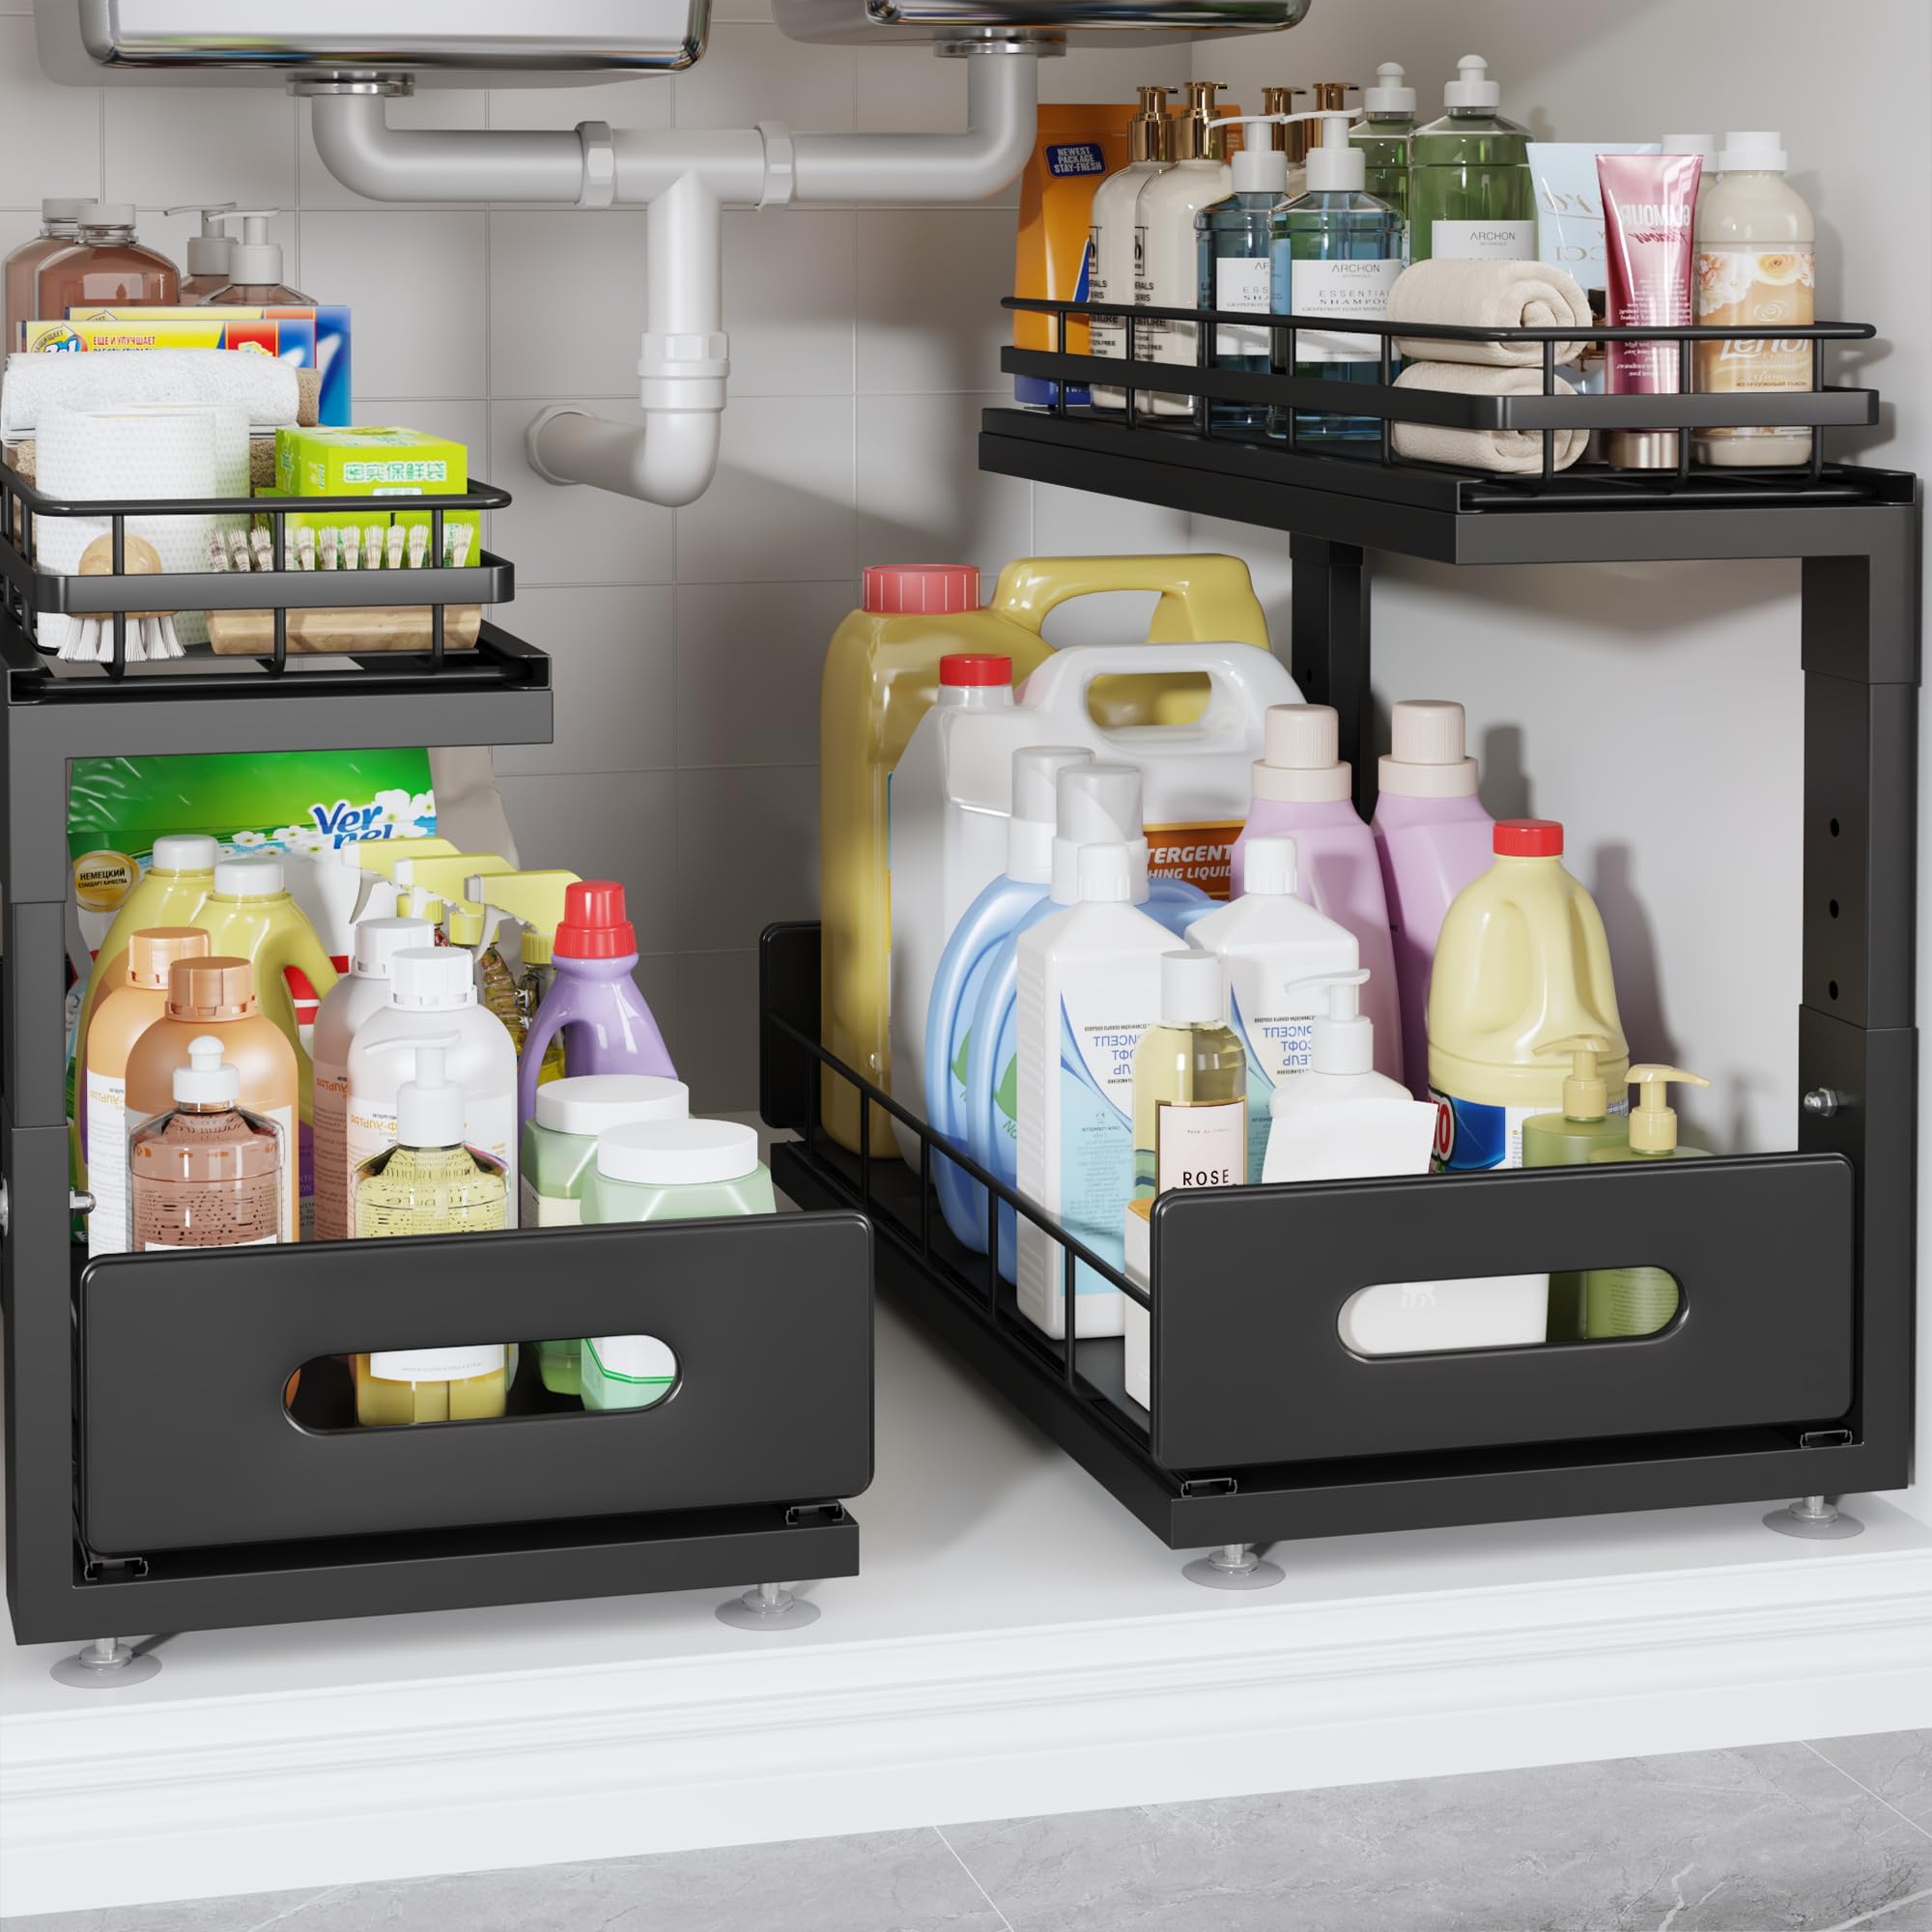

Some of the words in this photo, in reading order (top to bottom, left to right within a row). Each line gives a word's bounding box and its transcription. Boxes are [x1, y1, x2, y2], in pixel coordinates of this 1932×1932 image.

[1057, 147, 1090, 156] NEWEST
[1058, 155, 1094, 164] PACKAGE
[1054, 162, 1102, 173] STAY-FRESH
[1469, 232, 1516, 241] ARCHON
[1331, 264, 1380, 272] ARCHON
[94, 336, 108, 346] ЕЩЕ
[110, 336, 116, 346] И
[118, 336, 155, 346] УЛУЧШАЕТ
[312, 803, 384, 835] Ver
[80, 867, 126, 880] НЕМЕЦКИЙ
[1183, 1169, 1229, 1185] ROSE
